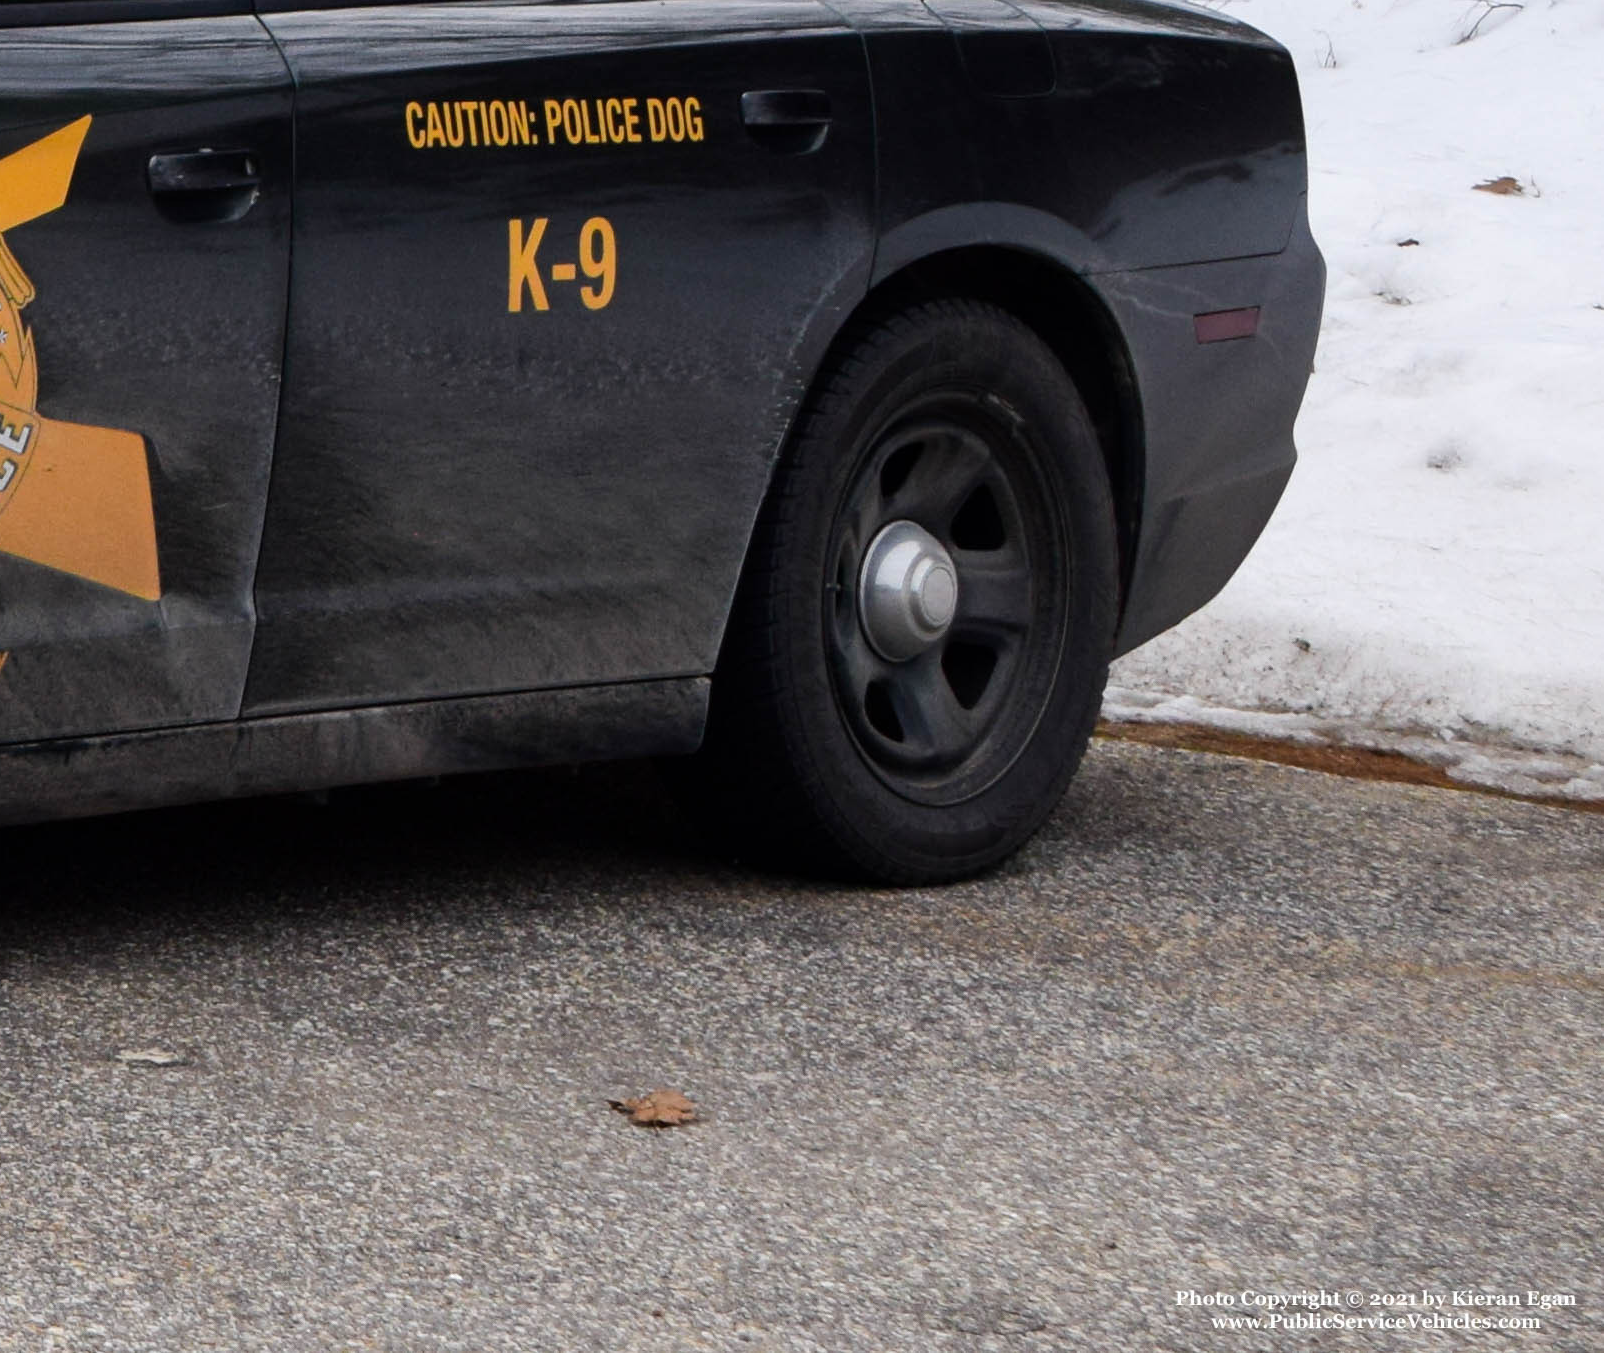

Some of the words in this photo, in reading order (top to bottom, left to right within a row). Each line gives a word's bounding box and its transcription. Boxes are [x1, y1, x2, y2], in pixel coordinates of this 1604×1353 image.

[405, 100, 537, 148] CAUTION:
[544, 97, 641, 144] POLICE
[648, 96, 704, 142] DOG
[508, 216, 617, 312] K-9
